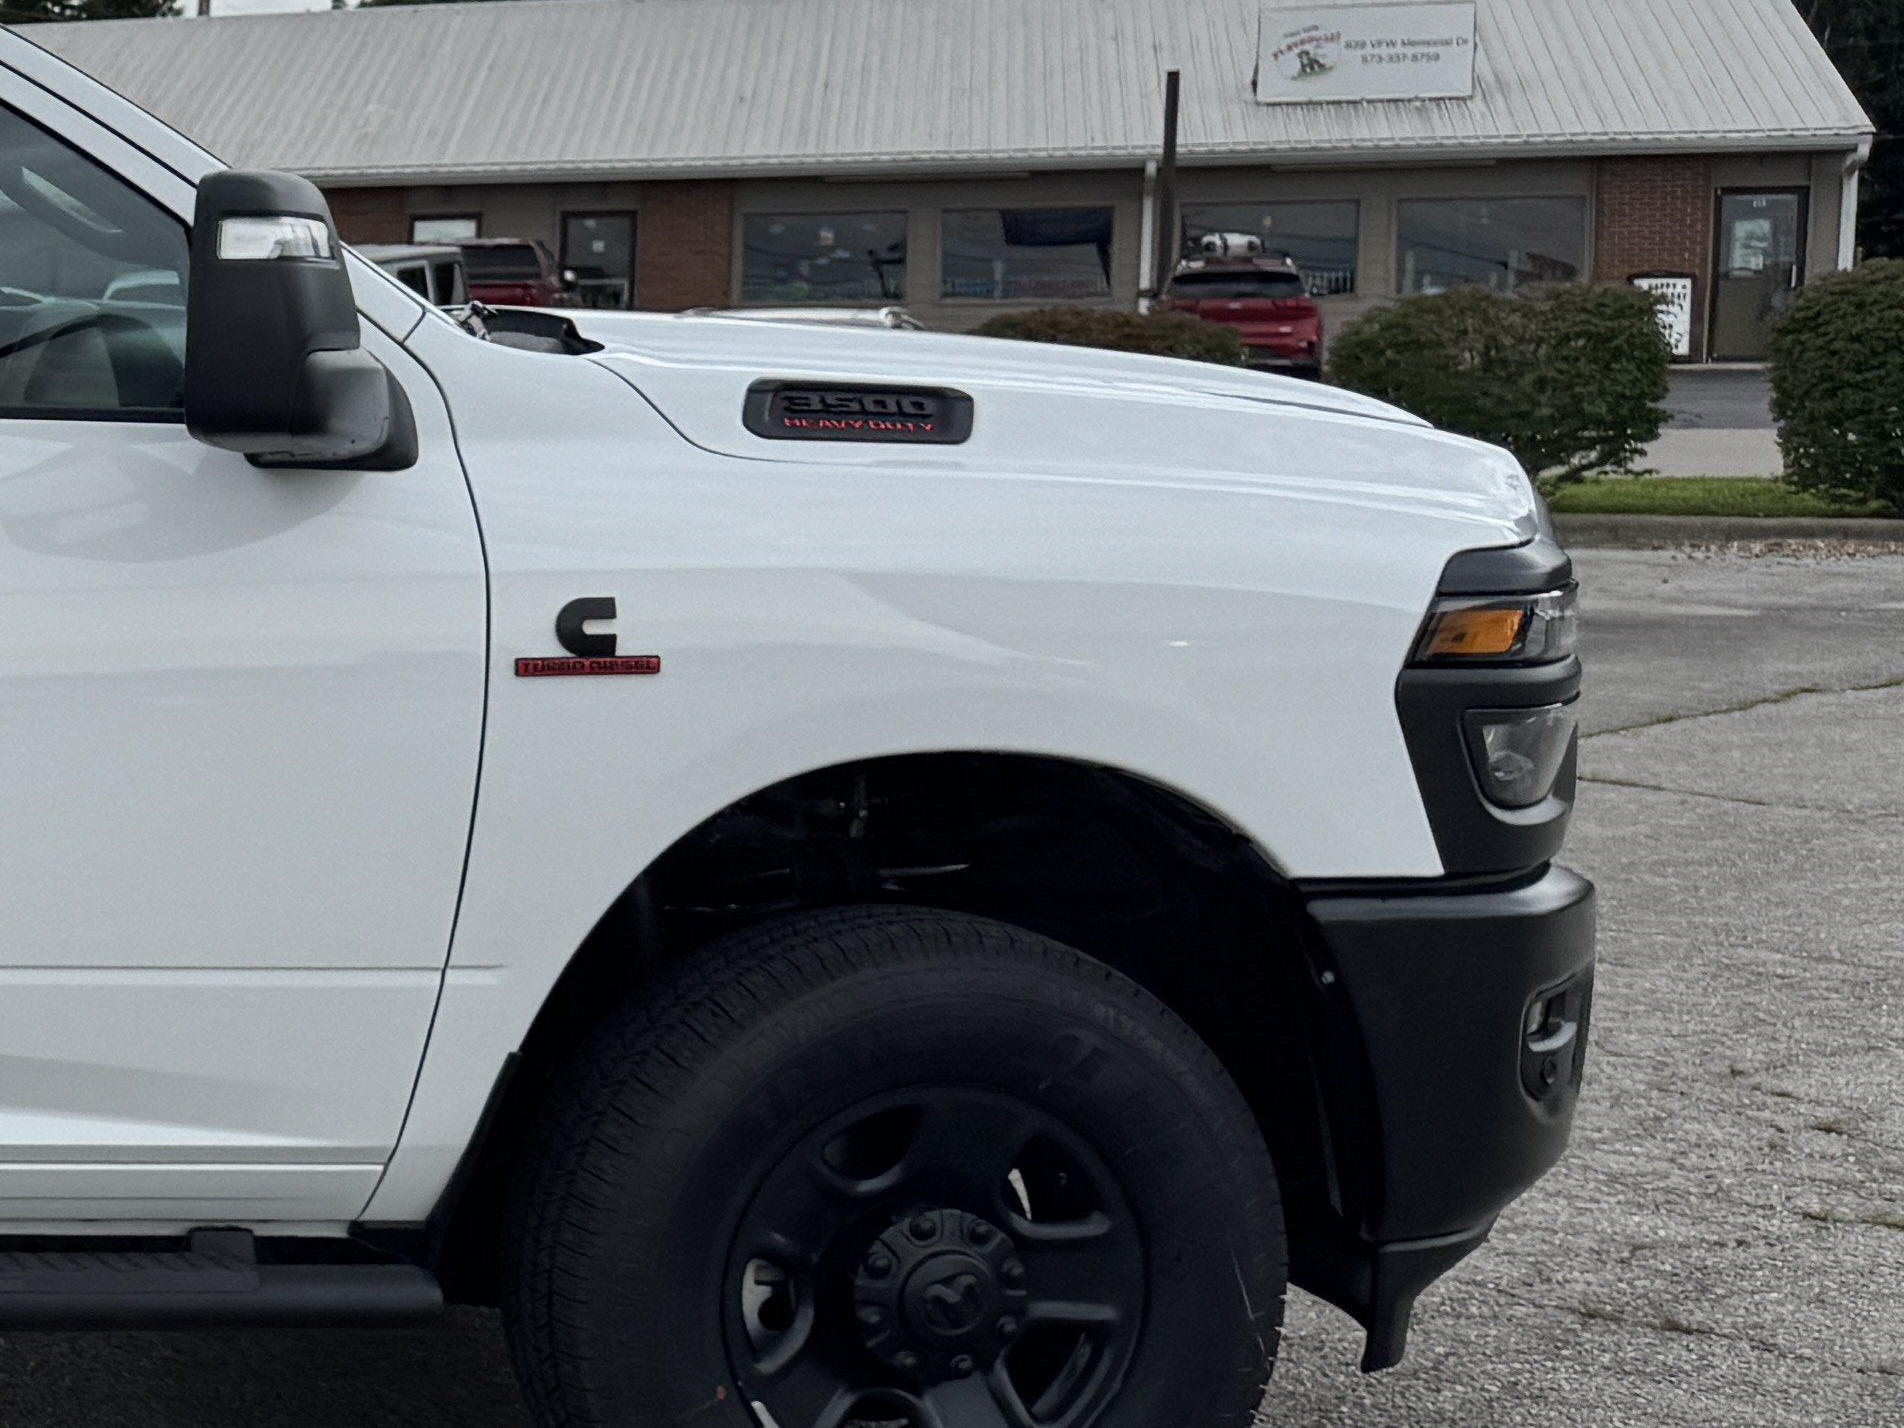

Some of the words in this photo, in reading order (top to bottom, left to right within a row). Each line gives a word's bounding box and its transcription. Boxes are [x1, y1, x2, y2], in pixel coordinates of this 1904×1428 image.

[782, 392, 934, 418] 3500
[783, 417, 862, 431] HEAVY
[868, 419, 934, 432] DUTY
